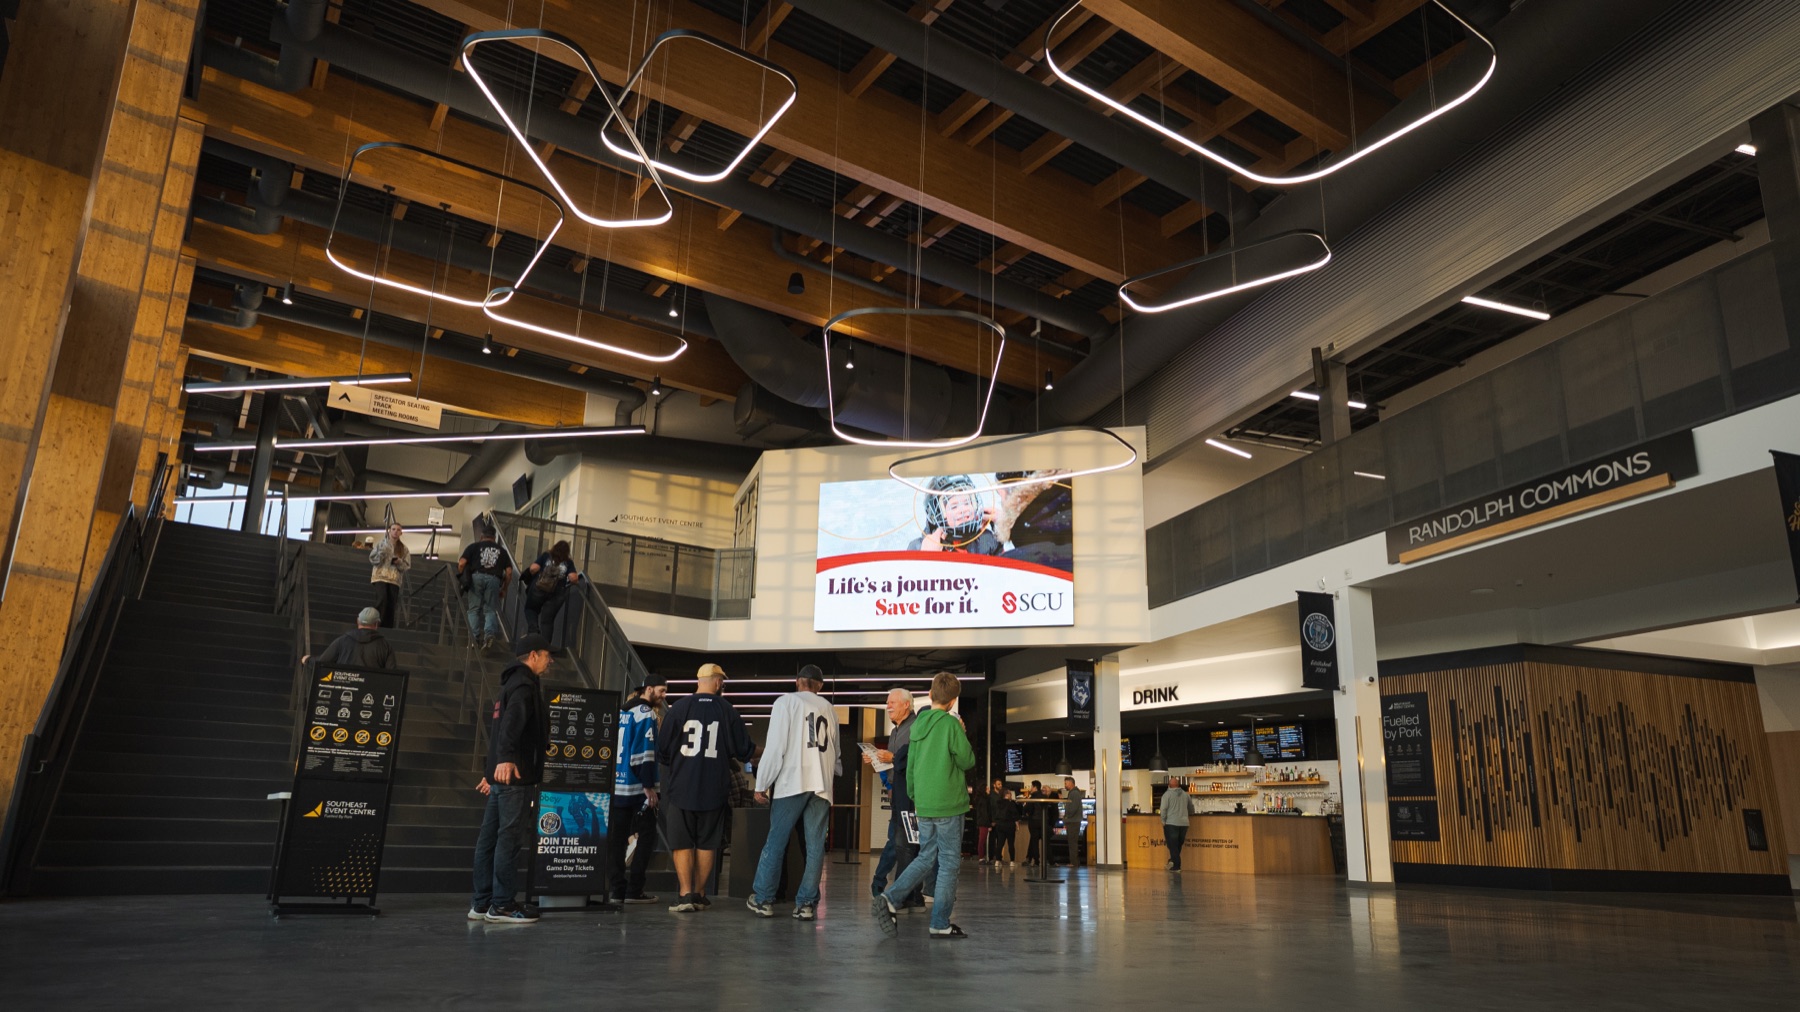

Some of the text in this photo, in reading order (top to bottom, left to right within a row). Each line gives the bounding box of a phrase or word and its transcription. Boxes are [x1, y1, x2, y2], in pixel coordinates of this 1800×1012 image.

[373, 401, 392, 410] TRACK
[374, 394, 430, 412] SPECTATOR SEATING
[372, 407, 418, 422] MEETING ROOMS
[1408, 452, 1651, 544] RANDOLPH COMMONS
[620, 514, 656, 523] SOUTHEAST
[828, 576, 979, 598] Life's a journey.
[875, 596, 979, 616] Save for it.
[1019, 592, 1064, 612] SCU
[1133, 686, 1179, 704] DRINK
[1384, 714, 1420, 726] Fuelled
[680, 720, 720, 758] 31
[805, 712, 828, 752] 10
[1384, 726, 1422, 741] by Pork
[537, 846, 597, 854] EXCITEMENT!
[538, 837, 559, 846] JOIN
